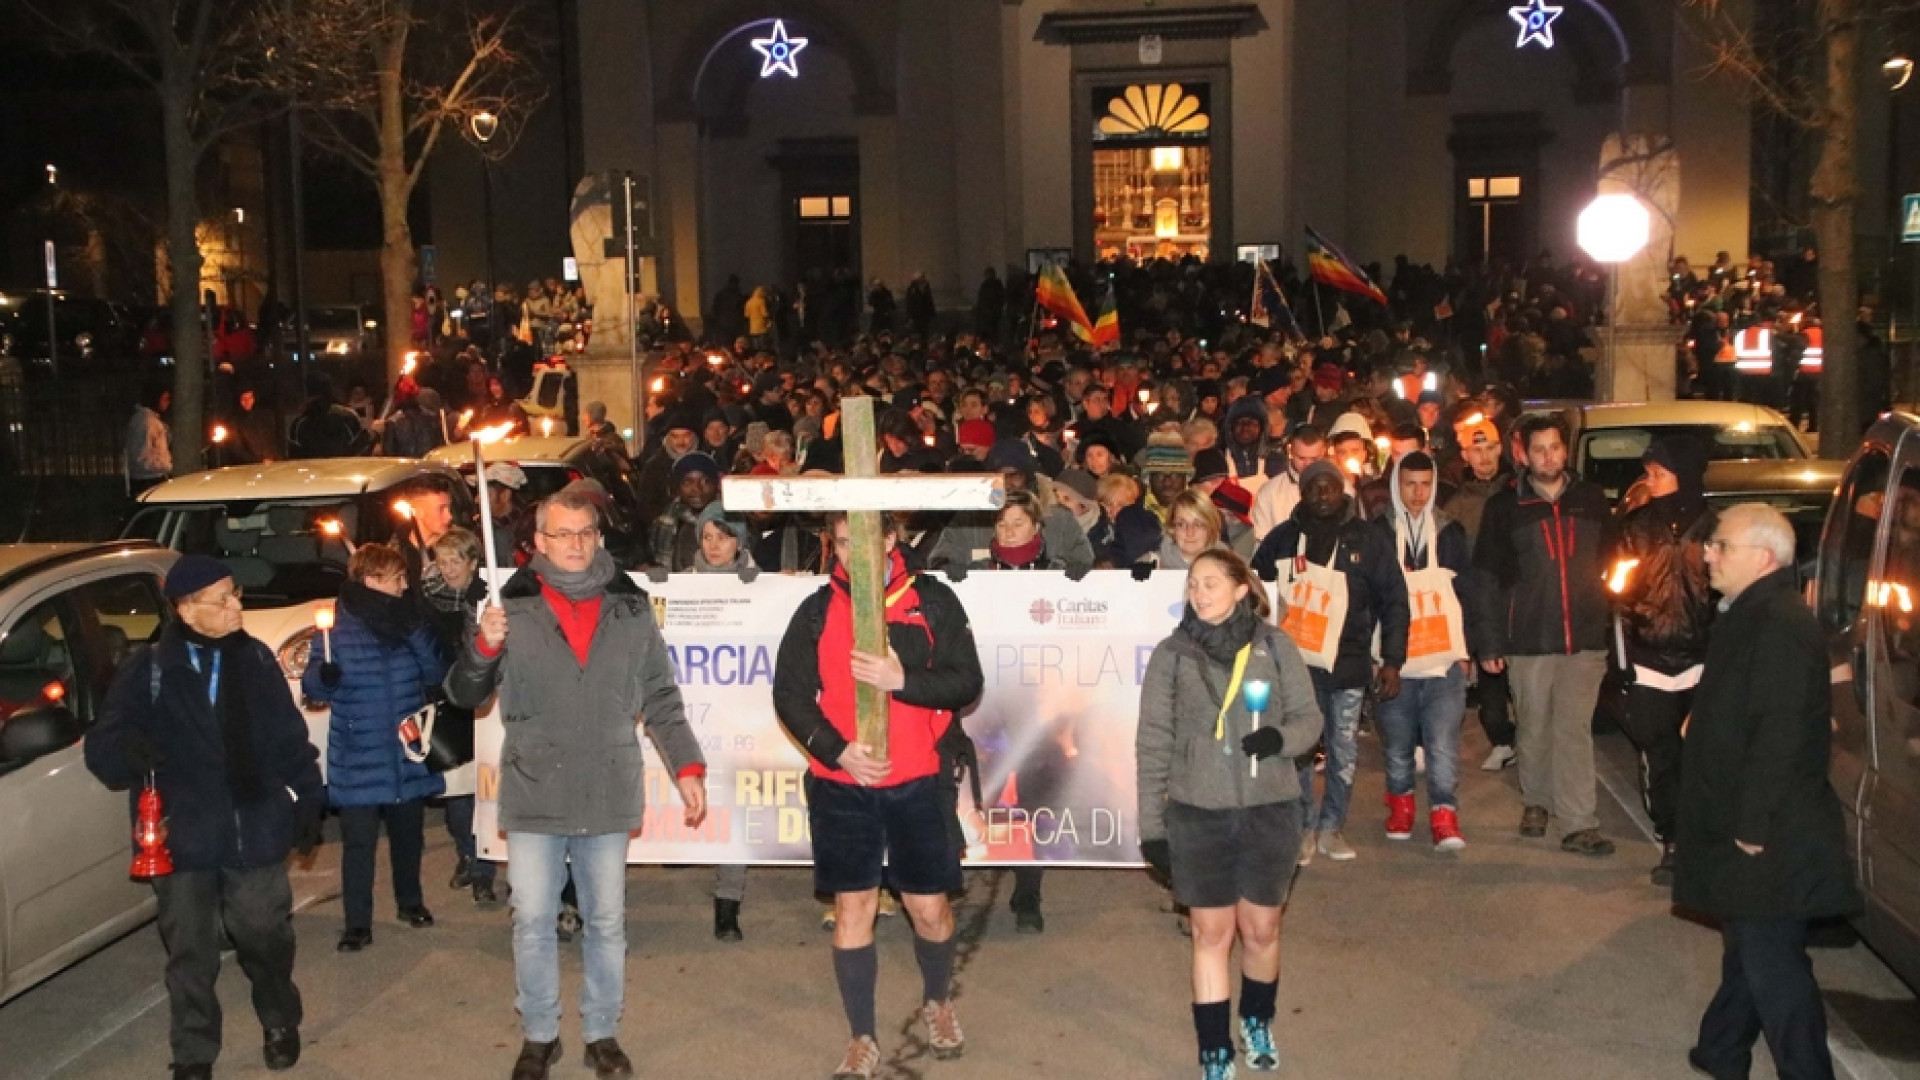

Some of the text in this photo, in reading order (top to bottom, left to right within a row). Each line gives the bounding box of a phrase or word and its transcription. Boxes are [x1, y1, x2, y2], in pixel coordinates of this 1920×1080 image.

[1056, 596, 1109, 613] Caritas
[996, 645, 1063, 685] PER
[1076, 645, 1123, 686] LA
[745, 807, 764, 844] E
[1091, 807, 1121, 846] DI
